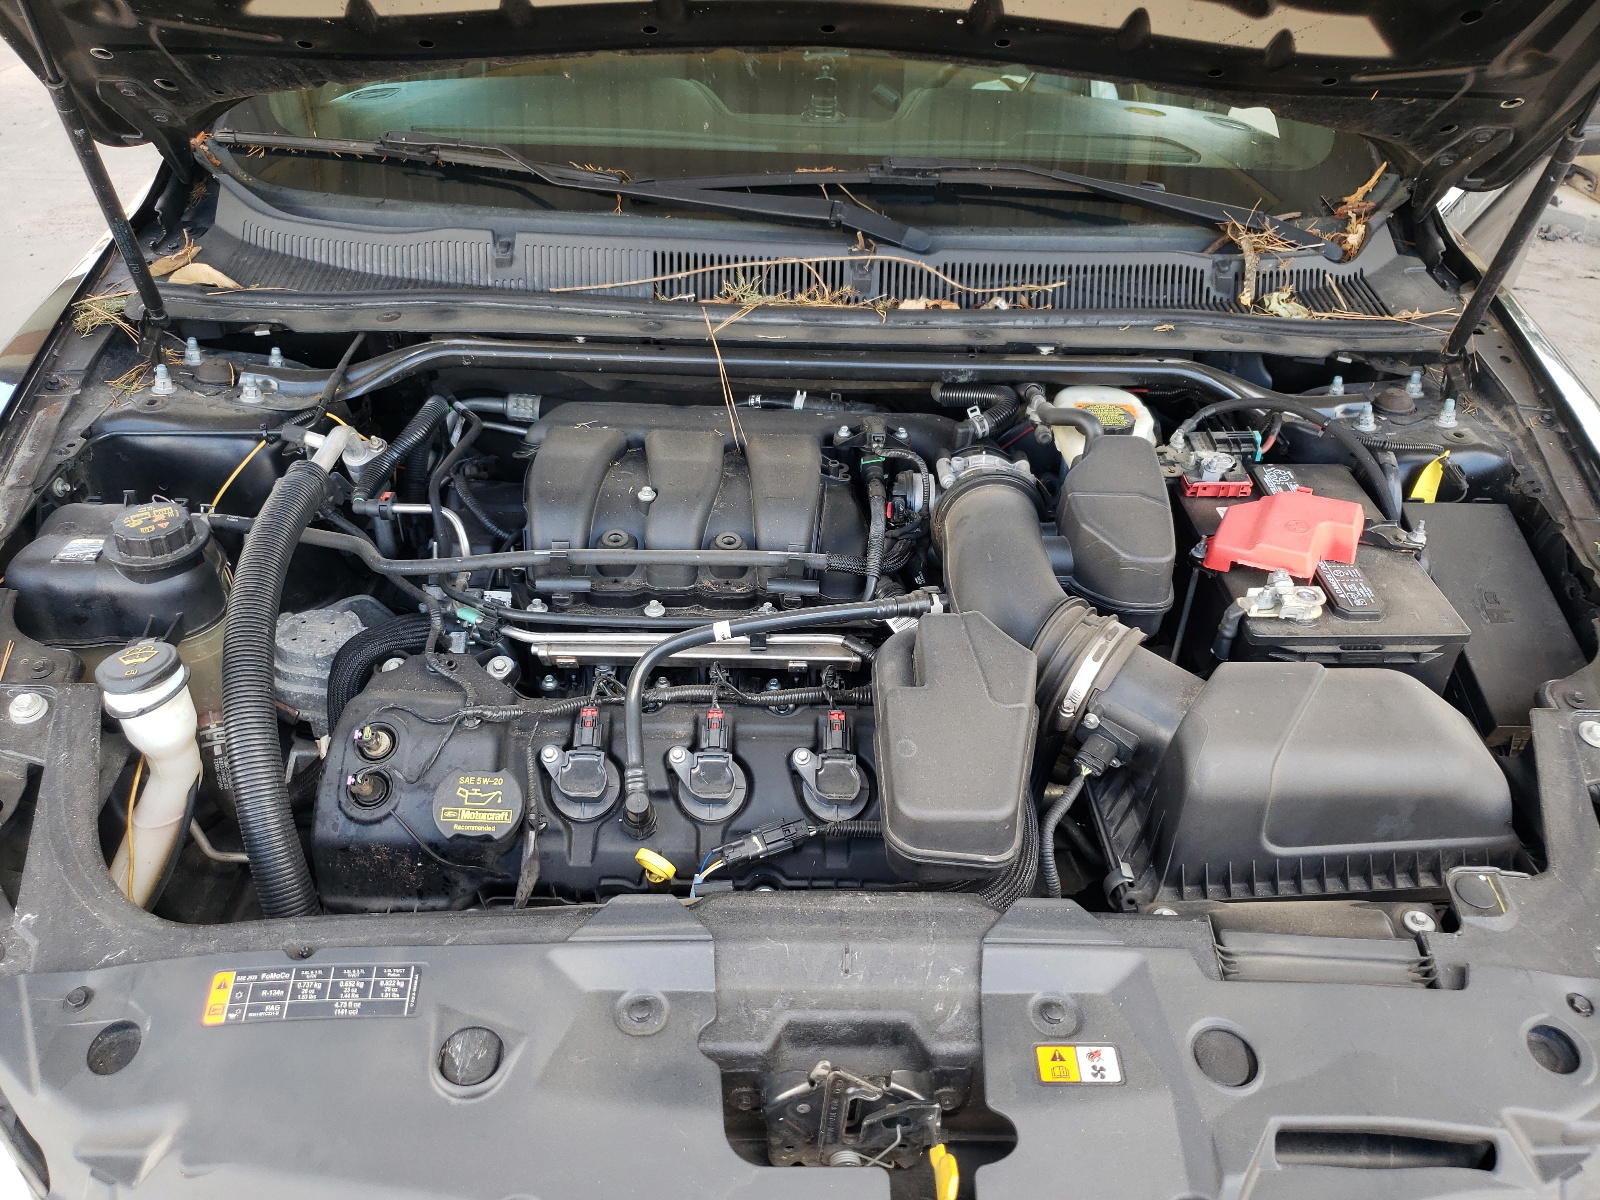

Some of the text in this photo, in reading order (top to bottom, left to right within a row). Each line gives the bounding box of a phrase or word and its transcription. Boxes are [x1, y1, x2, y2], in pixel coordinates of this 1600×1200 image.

[459, 776, 504, 786] SAE 5W-20
[460, 809, 510, 823] Motorcraft
[453, 824, 496, 832] Recommended
[261, 971, 290, 981] FoMoCo
[297, 981, 323, 990] 0.737 kg
[339, 980, 365, 989] 0.652 kg
[396, 979, 405, 988] kg
